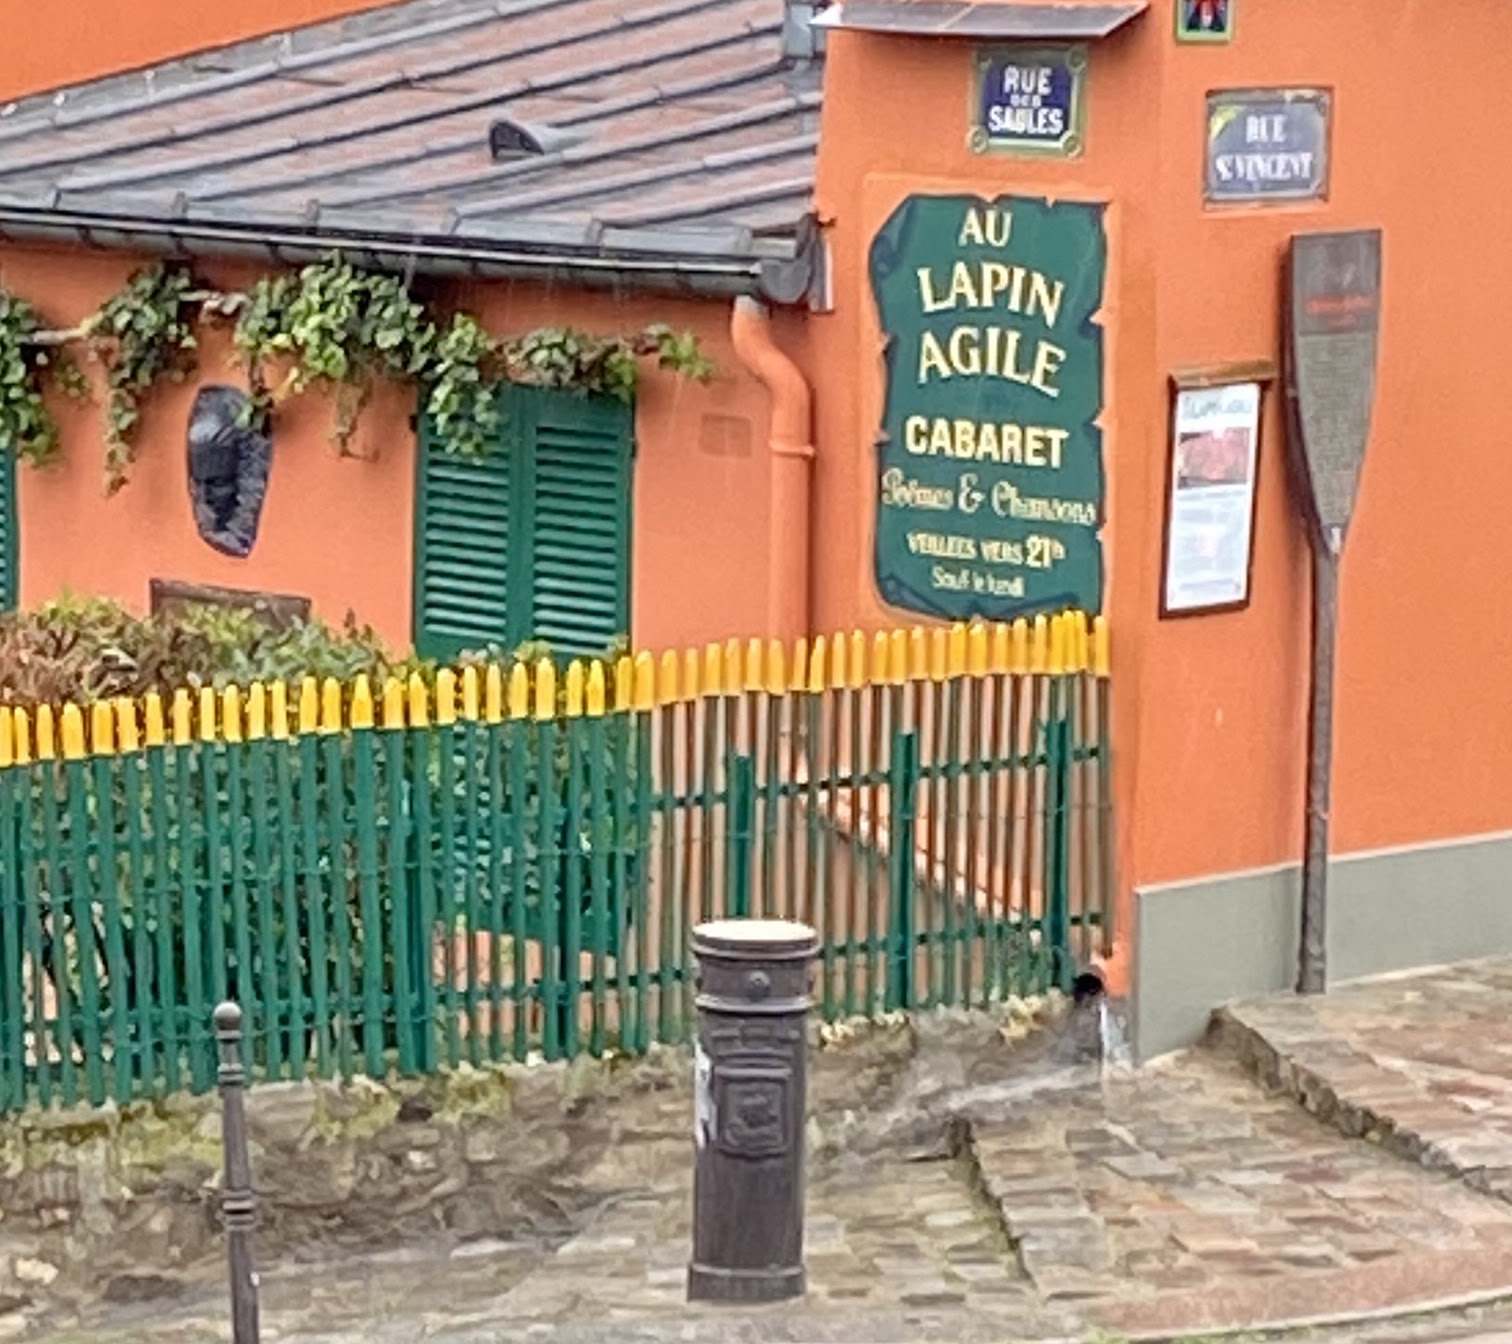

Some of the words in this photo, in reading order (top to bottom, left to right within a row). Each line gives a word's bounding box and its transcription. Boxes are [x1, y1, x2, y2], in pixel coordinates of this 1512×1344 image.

[1004, 65, 1052, 95] RUE
[988, 105, 1064, 135] SAULES
[1245, 114, 1286, 143] RUE
[958, 207, 1012, 248] AU
[916, 260, 1065, 329] LAPIN
[917, 327, 1066, 398] AGILE
[904, 415, 1069, 469] CABARET
[958, 472, 986, 514] &
[991, 480, 1097, 527] Chansons
